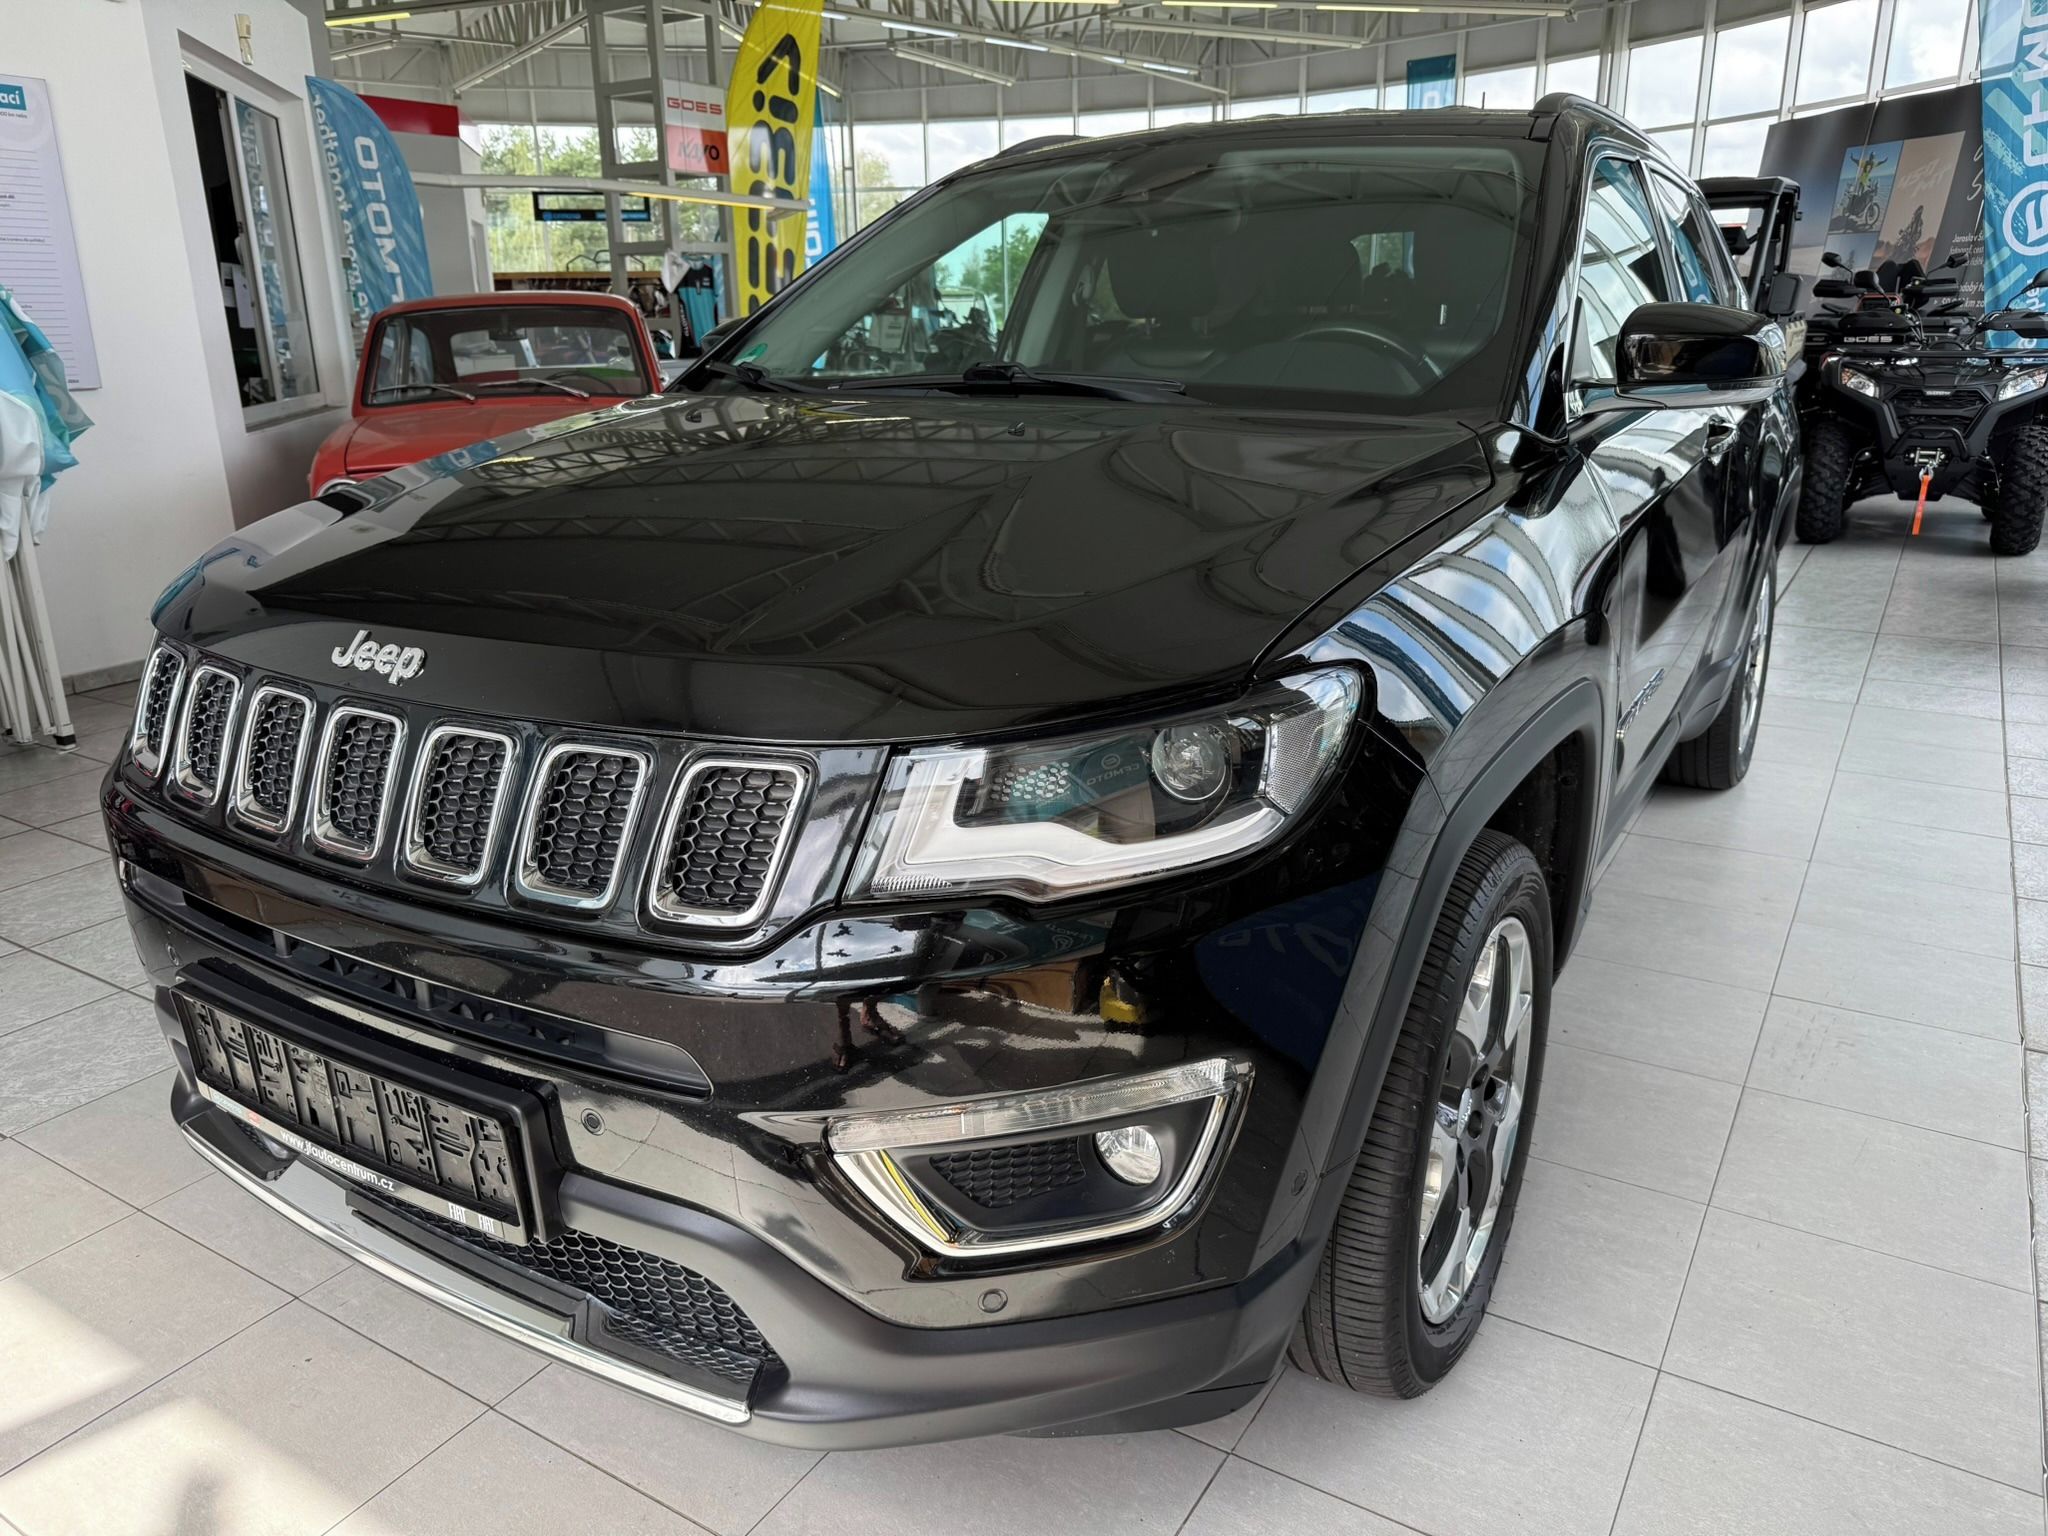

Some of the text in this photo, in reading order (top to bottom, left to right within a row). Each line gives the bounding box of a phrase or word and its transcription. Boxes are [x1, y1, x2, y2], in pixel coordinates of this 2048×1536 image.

[667, 97, 722, 115] GOES
[748, 33, 801, 316] ERBIS
[331, 629, 425, 685] Jeep
[280, 1131, 395, 1192] www.jfautocentrum.cz
[448, 1202, 495, 1233] FIAT FIAT
